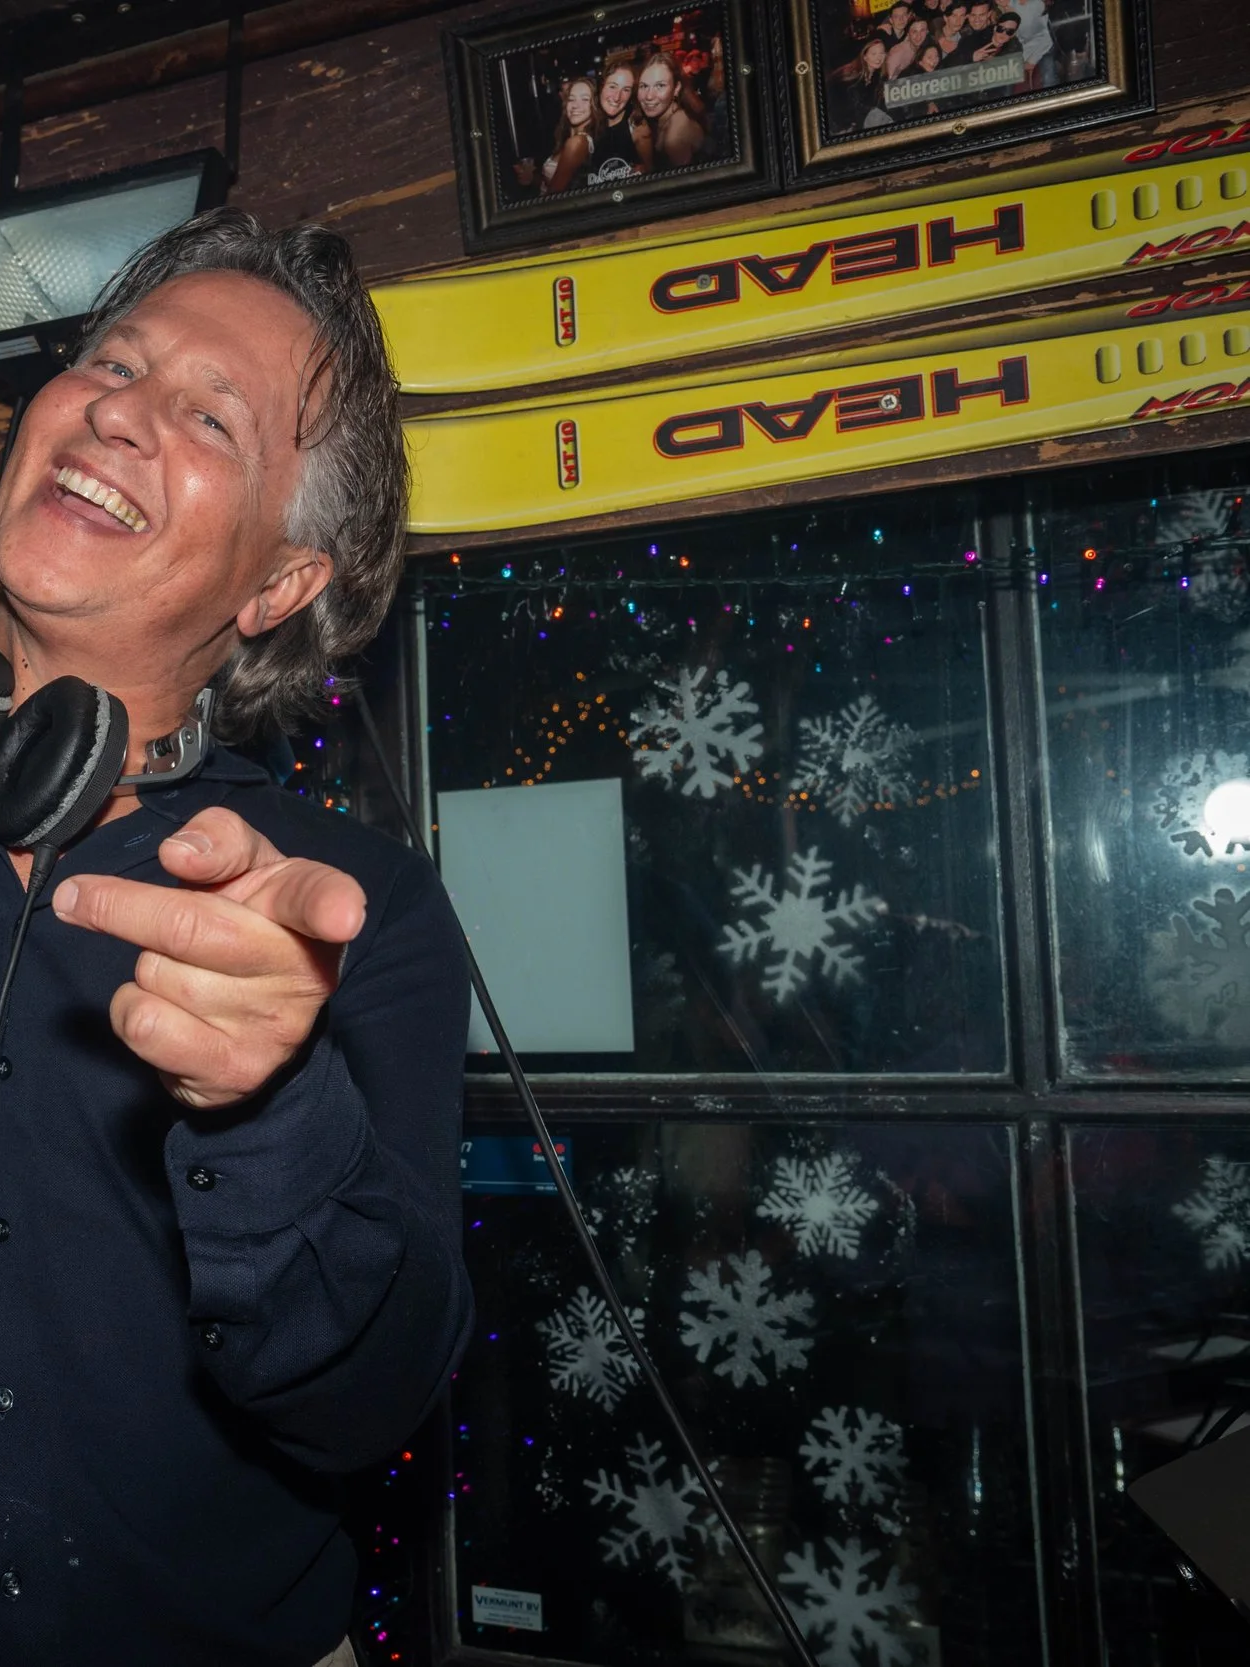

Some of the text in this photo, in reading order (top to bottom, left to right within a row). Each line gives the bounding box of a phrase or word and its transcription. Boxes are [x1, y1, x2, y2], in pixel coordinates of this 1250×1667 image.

[884, 58, 1021, 102] Iedereen stonk
[650, 203, 1025, 314] HEAD
[558, 278, 575, 340] MT 10
[653, 356, 1029, 459] HEAD
[561, 422, 577, 483] MT 10
